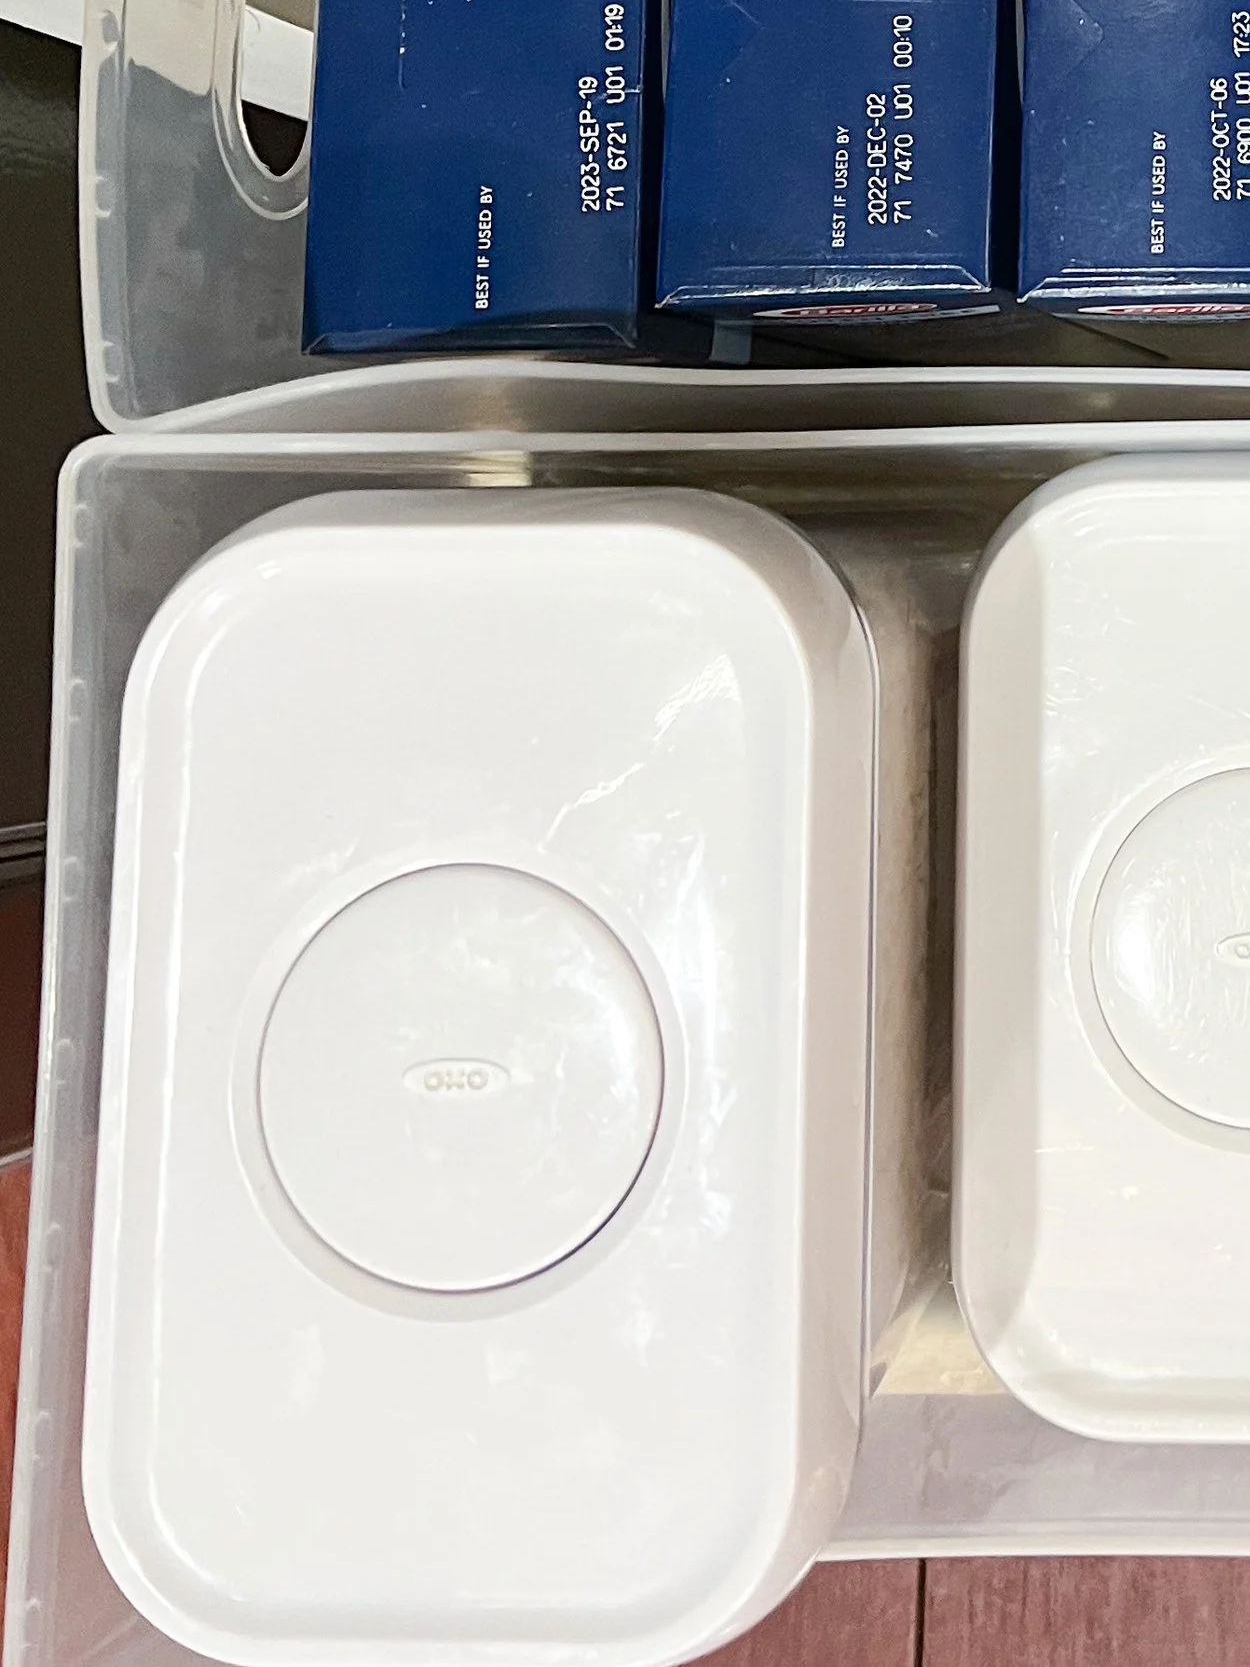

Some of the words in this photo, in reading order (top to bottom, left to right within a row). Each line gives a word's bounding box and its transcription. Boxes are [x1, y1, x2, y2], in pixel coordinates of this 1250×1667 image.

[605, 3, 624, 51] 01:19
[893, 15, 913, 68] 00:10
[1232, 11, 1250, 58] 17:23
[578, 76, 600, 212] 2023-SEP-19
[606, 121, 627, 171] 6721
[837, 126, 849, 144] BY
[1153, 131, 1167, 150] BY
[1210, 78, 1231, 201] 2022-OCT-06
[835, 149, 849, 189] USED
[867, 93, 887, 225] 2022-DEC-02
[895, 134, 913, 183] 7470
[1152, 155, 1165, 195] USED
[480, 186, 493, 204] BY
[606, 186, 624, 212] 71
[834, 195, 846, 208] IF
[894, 200, 912, 223] 71
[1152, 199, 1164, 213] IF
[478, 209, 492, 250] USED
[832, 213, 845, 248] BEST
[1151, 218, 1164, 254] BEST
[477, 255, 490, 268] IF
[475, 274, 489, 310] BEST
